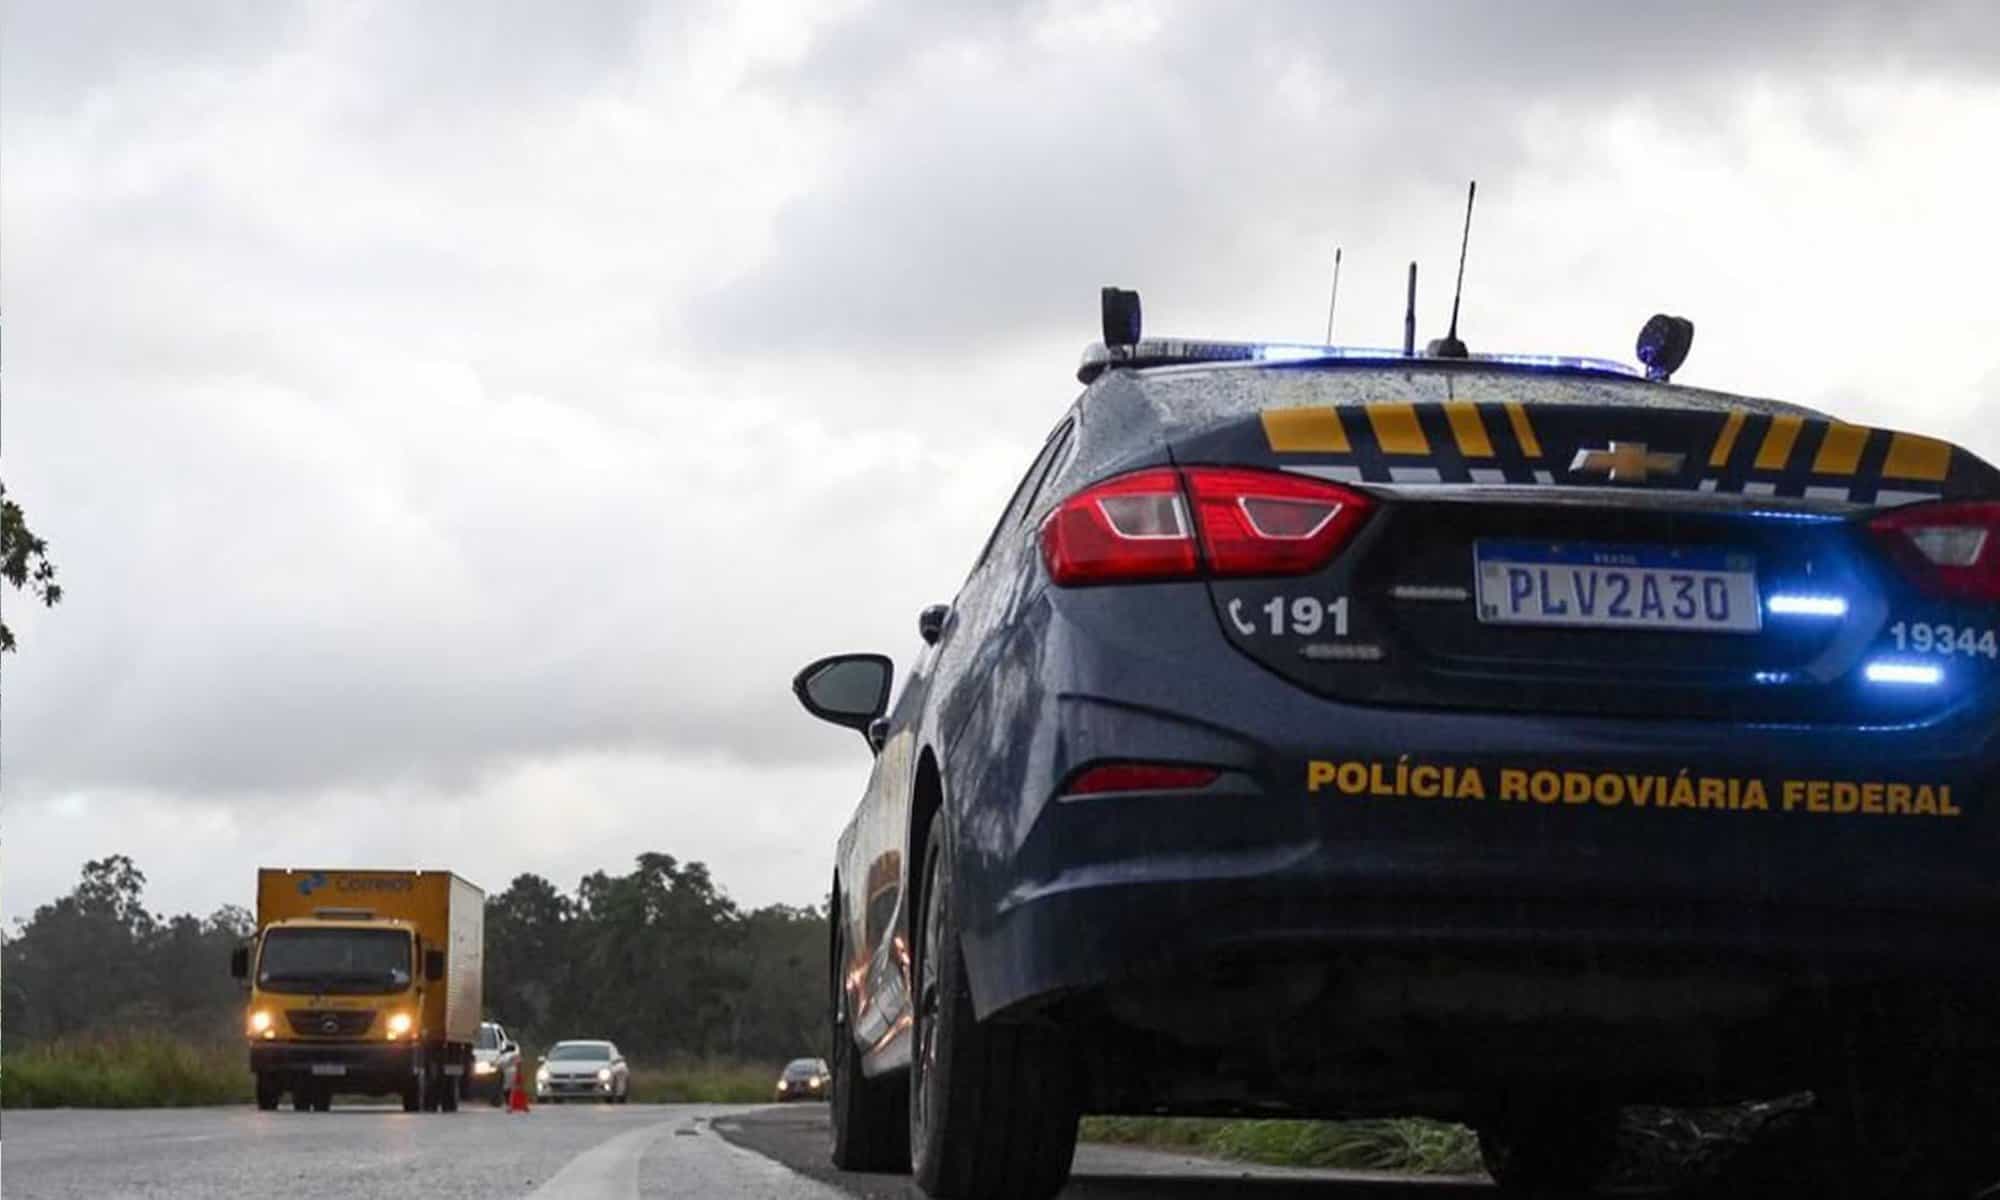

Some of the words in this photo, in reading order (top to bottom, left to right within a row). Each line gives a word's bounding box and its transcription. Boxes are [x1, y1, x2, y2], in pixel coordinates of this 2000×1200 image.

[1263, 596, 1349, 636] 191
[1507, 568, 1731, 621] PLV2A30
[1890, 621, 1997, 658] 19344
[1307, 754, 1485, 799] POLÍCIA
[1500, 768, 1768, 812] RODOVIÁRIA
[1782, 780, 1961, 816] FEDERAL
